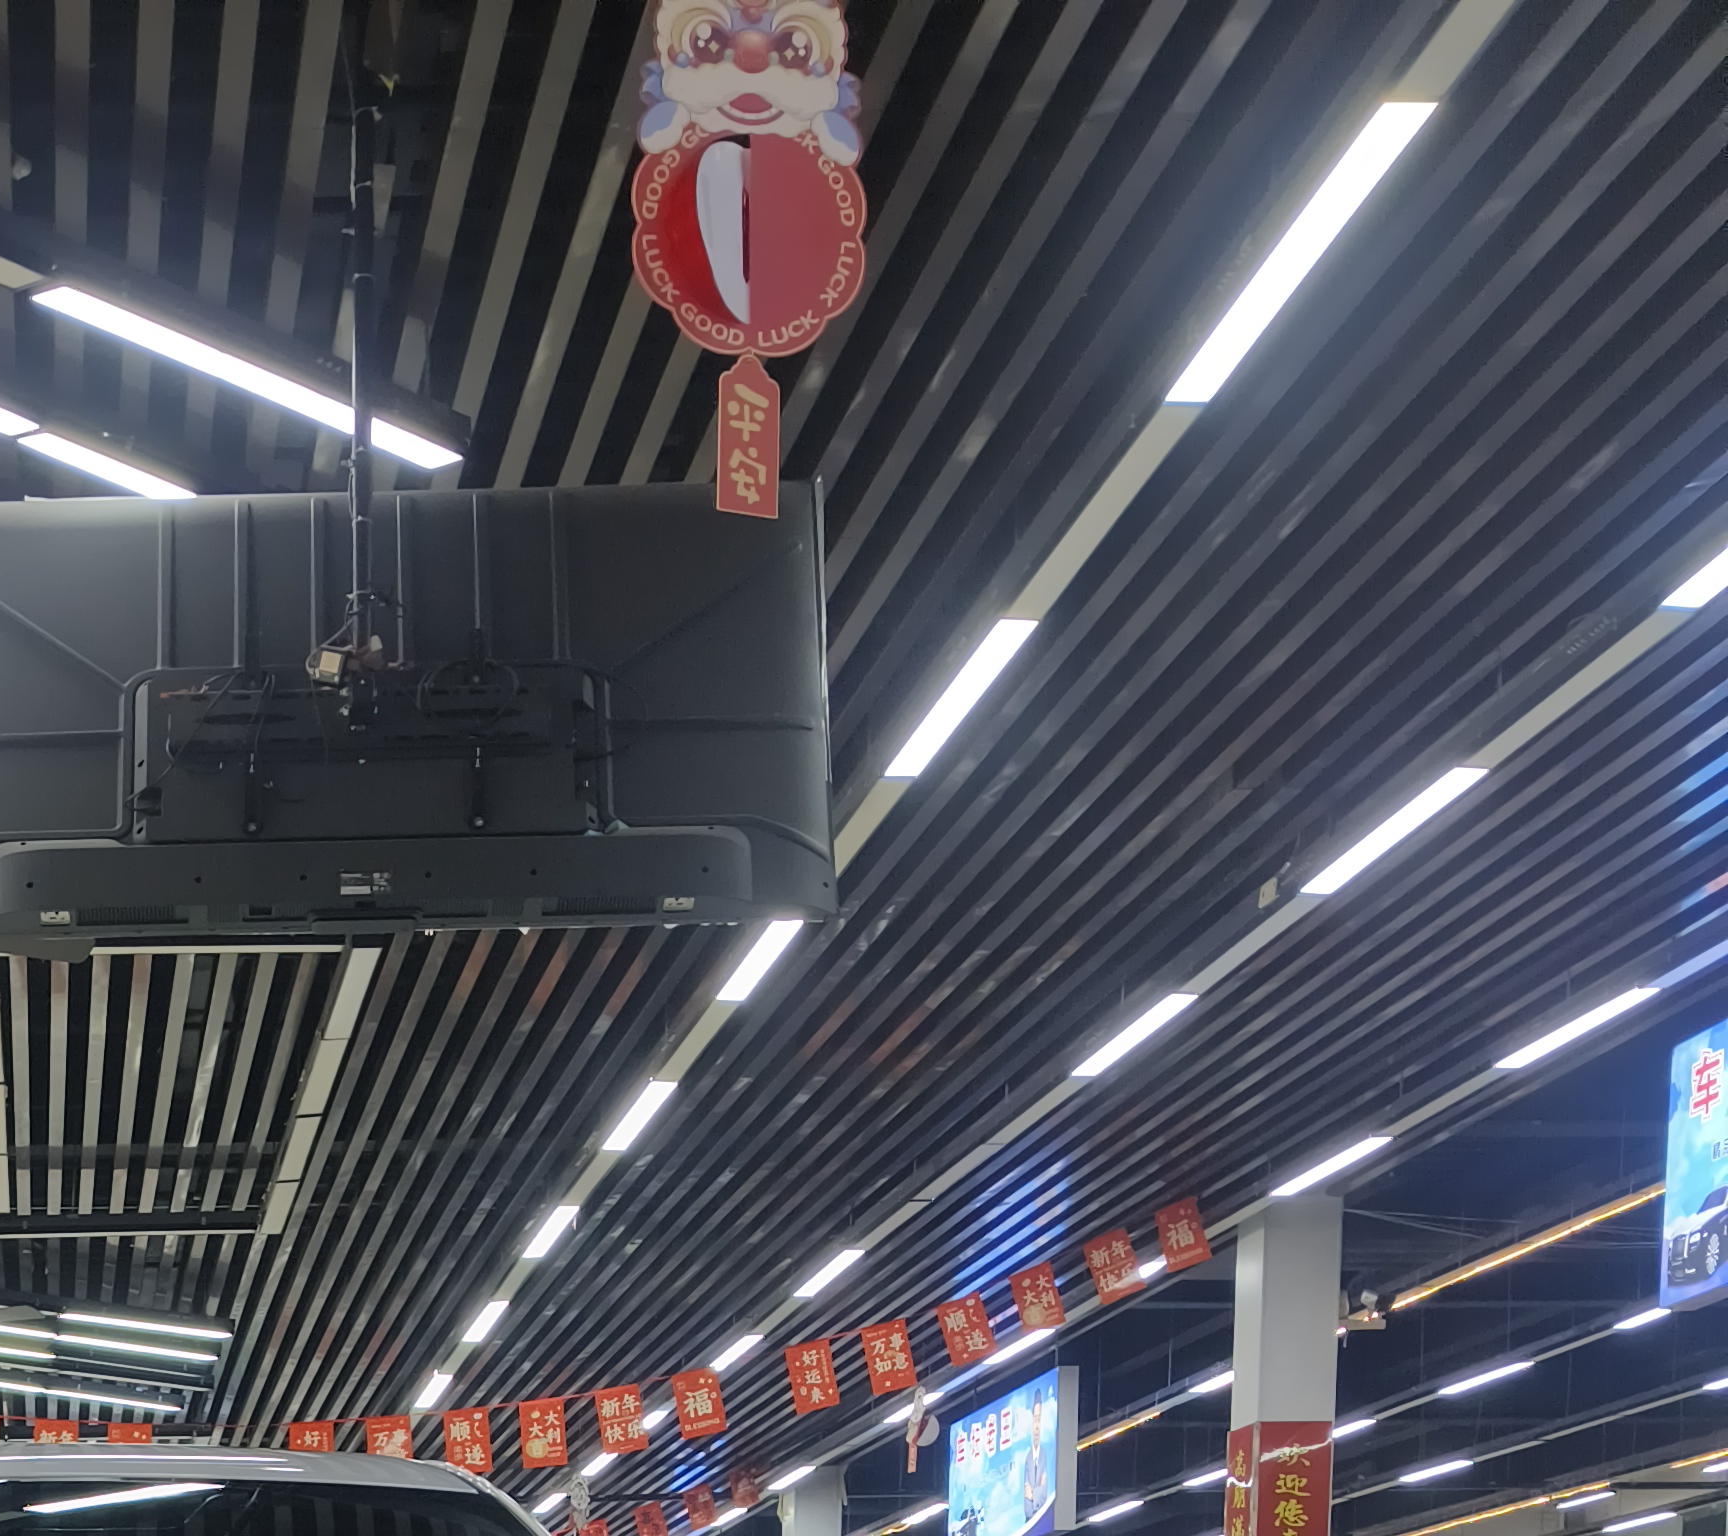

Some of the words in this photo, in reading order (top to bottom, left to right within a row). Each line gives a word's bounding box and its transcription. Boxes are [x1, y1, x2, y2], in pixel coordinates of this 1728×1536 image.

[642, 149, 681, 219] GOOD
[818, 154, 855, 226] GOOD
[642, 234, 681, 303] LUCK
[819, 241, 856, 307] LUCK
[680, 302, 745, 346] GOOD
[758, 309, 819, 347] LUCK
[726, 383, 770, 504] 平安
[1690, 1051, 1723, 1121] 车
[1090, 1240, 1131, 1268] 新年
[1166, 1219, 1195, 1251] 福
[870, 1332, 905, 1355] 万事
[874, 1352, 909, 1375] 如意
[801, 1350, 825, 1404] 好运来
[600, 1393, 640, 1419] 新年
[683, 1388, 714, 1418] 福
[604, 1419, 644, 1444] 快乐
